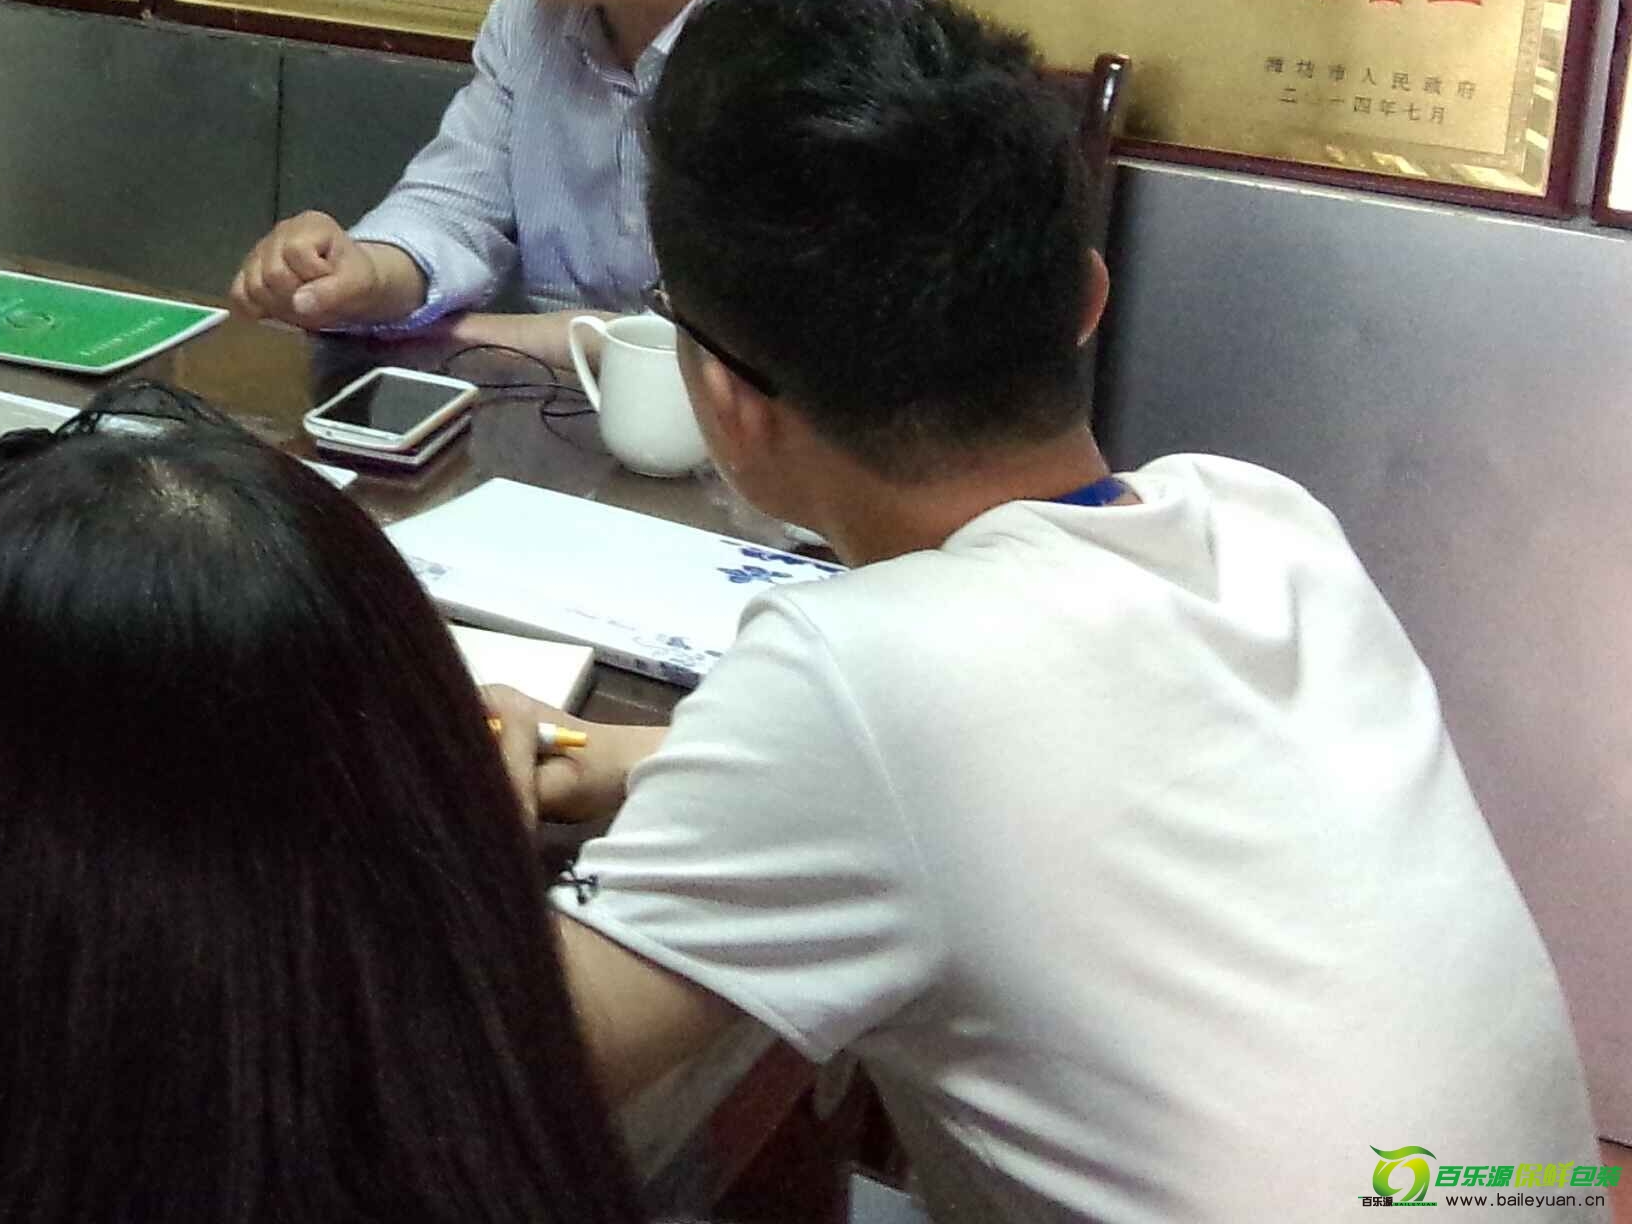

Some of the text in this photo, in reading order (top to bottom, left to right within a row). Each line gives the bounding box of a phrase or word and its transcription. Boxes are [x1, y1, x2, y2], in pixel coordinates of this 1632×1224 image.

[1264, 56, 1477, 101] 潍坊市人民政府
